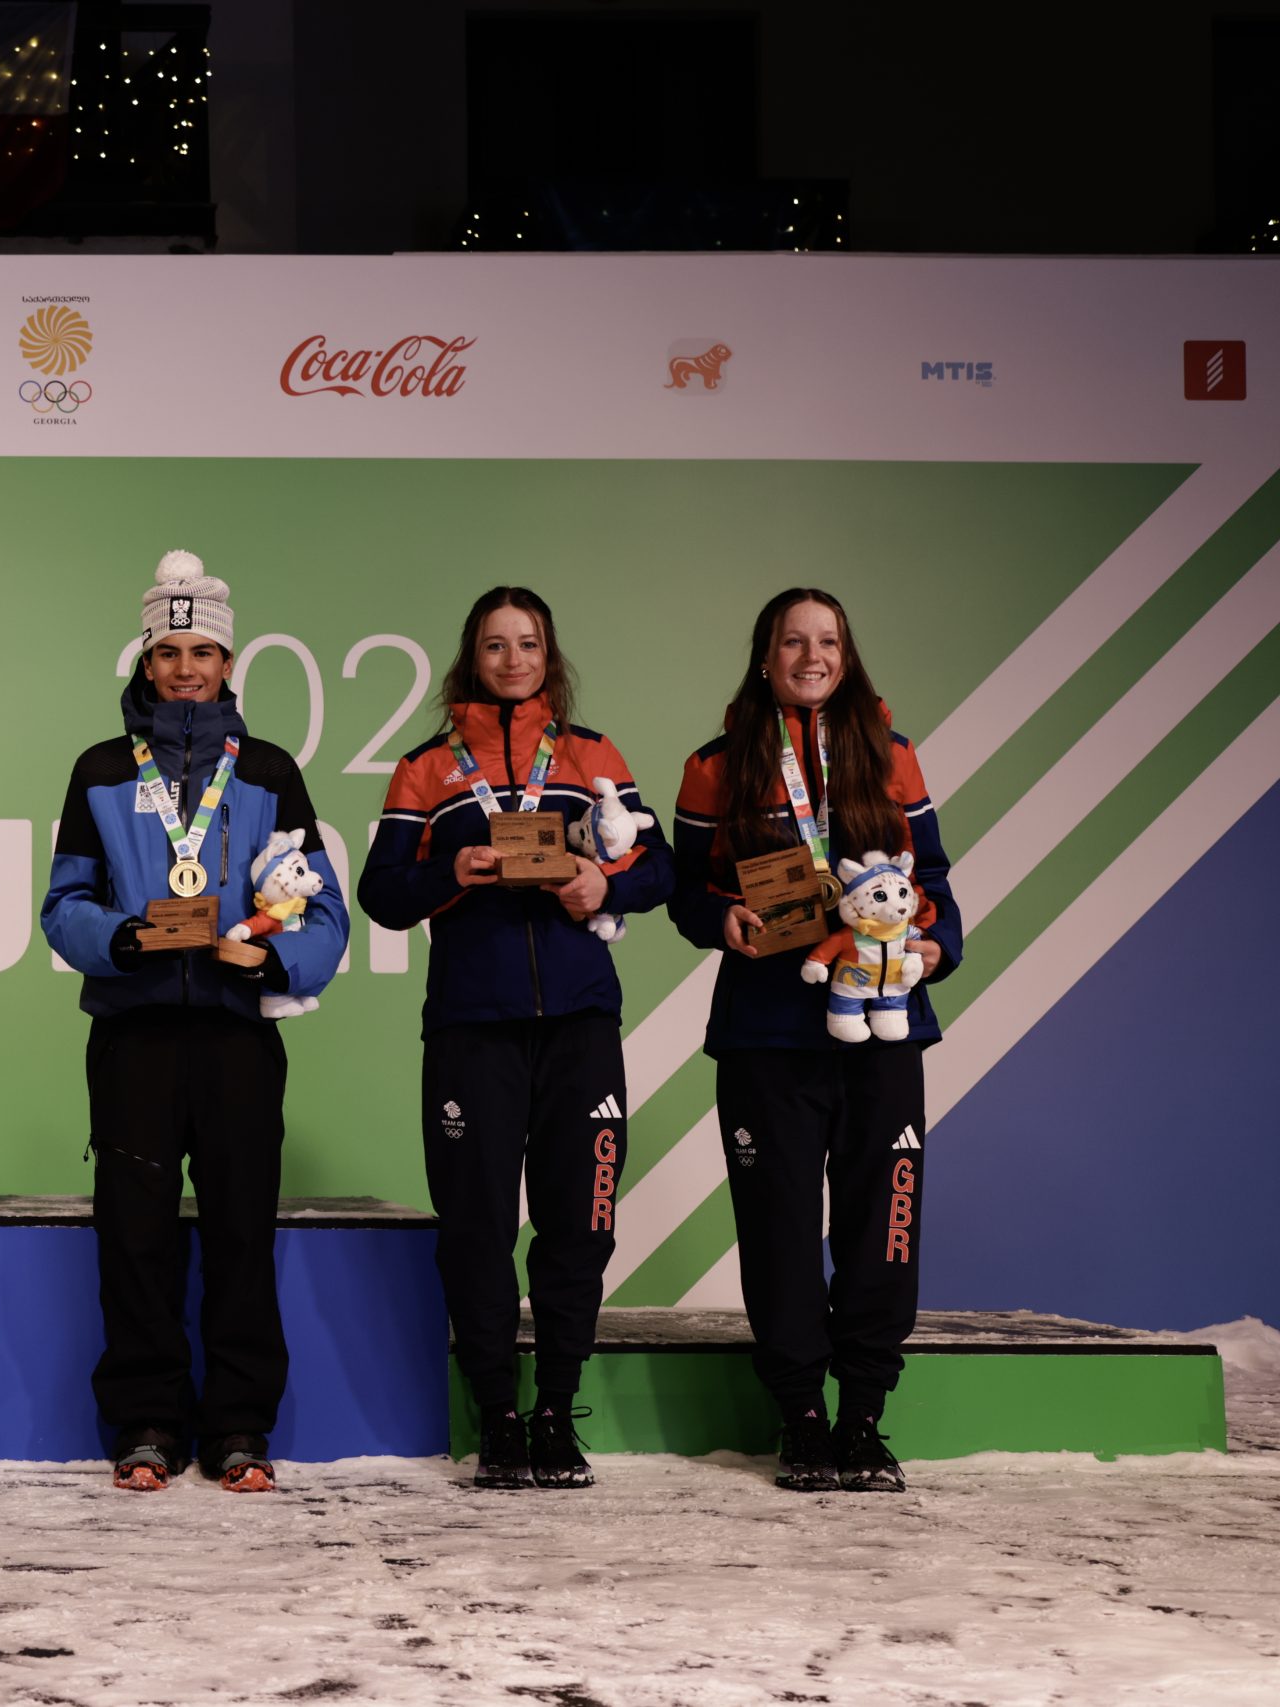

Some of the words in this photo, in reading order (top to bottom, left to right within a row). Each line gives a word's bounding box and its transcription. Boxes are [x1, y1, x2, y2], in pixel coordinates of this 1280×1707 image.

[280, 334, 479, 398] Coca-Cola
[921, 361, 993, 381] MTIS
[591, 1128, 617, 1231] GBR
[886, 1157, 916, 1264] GBR
